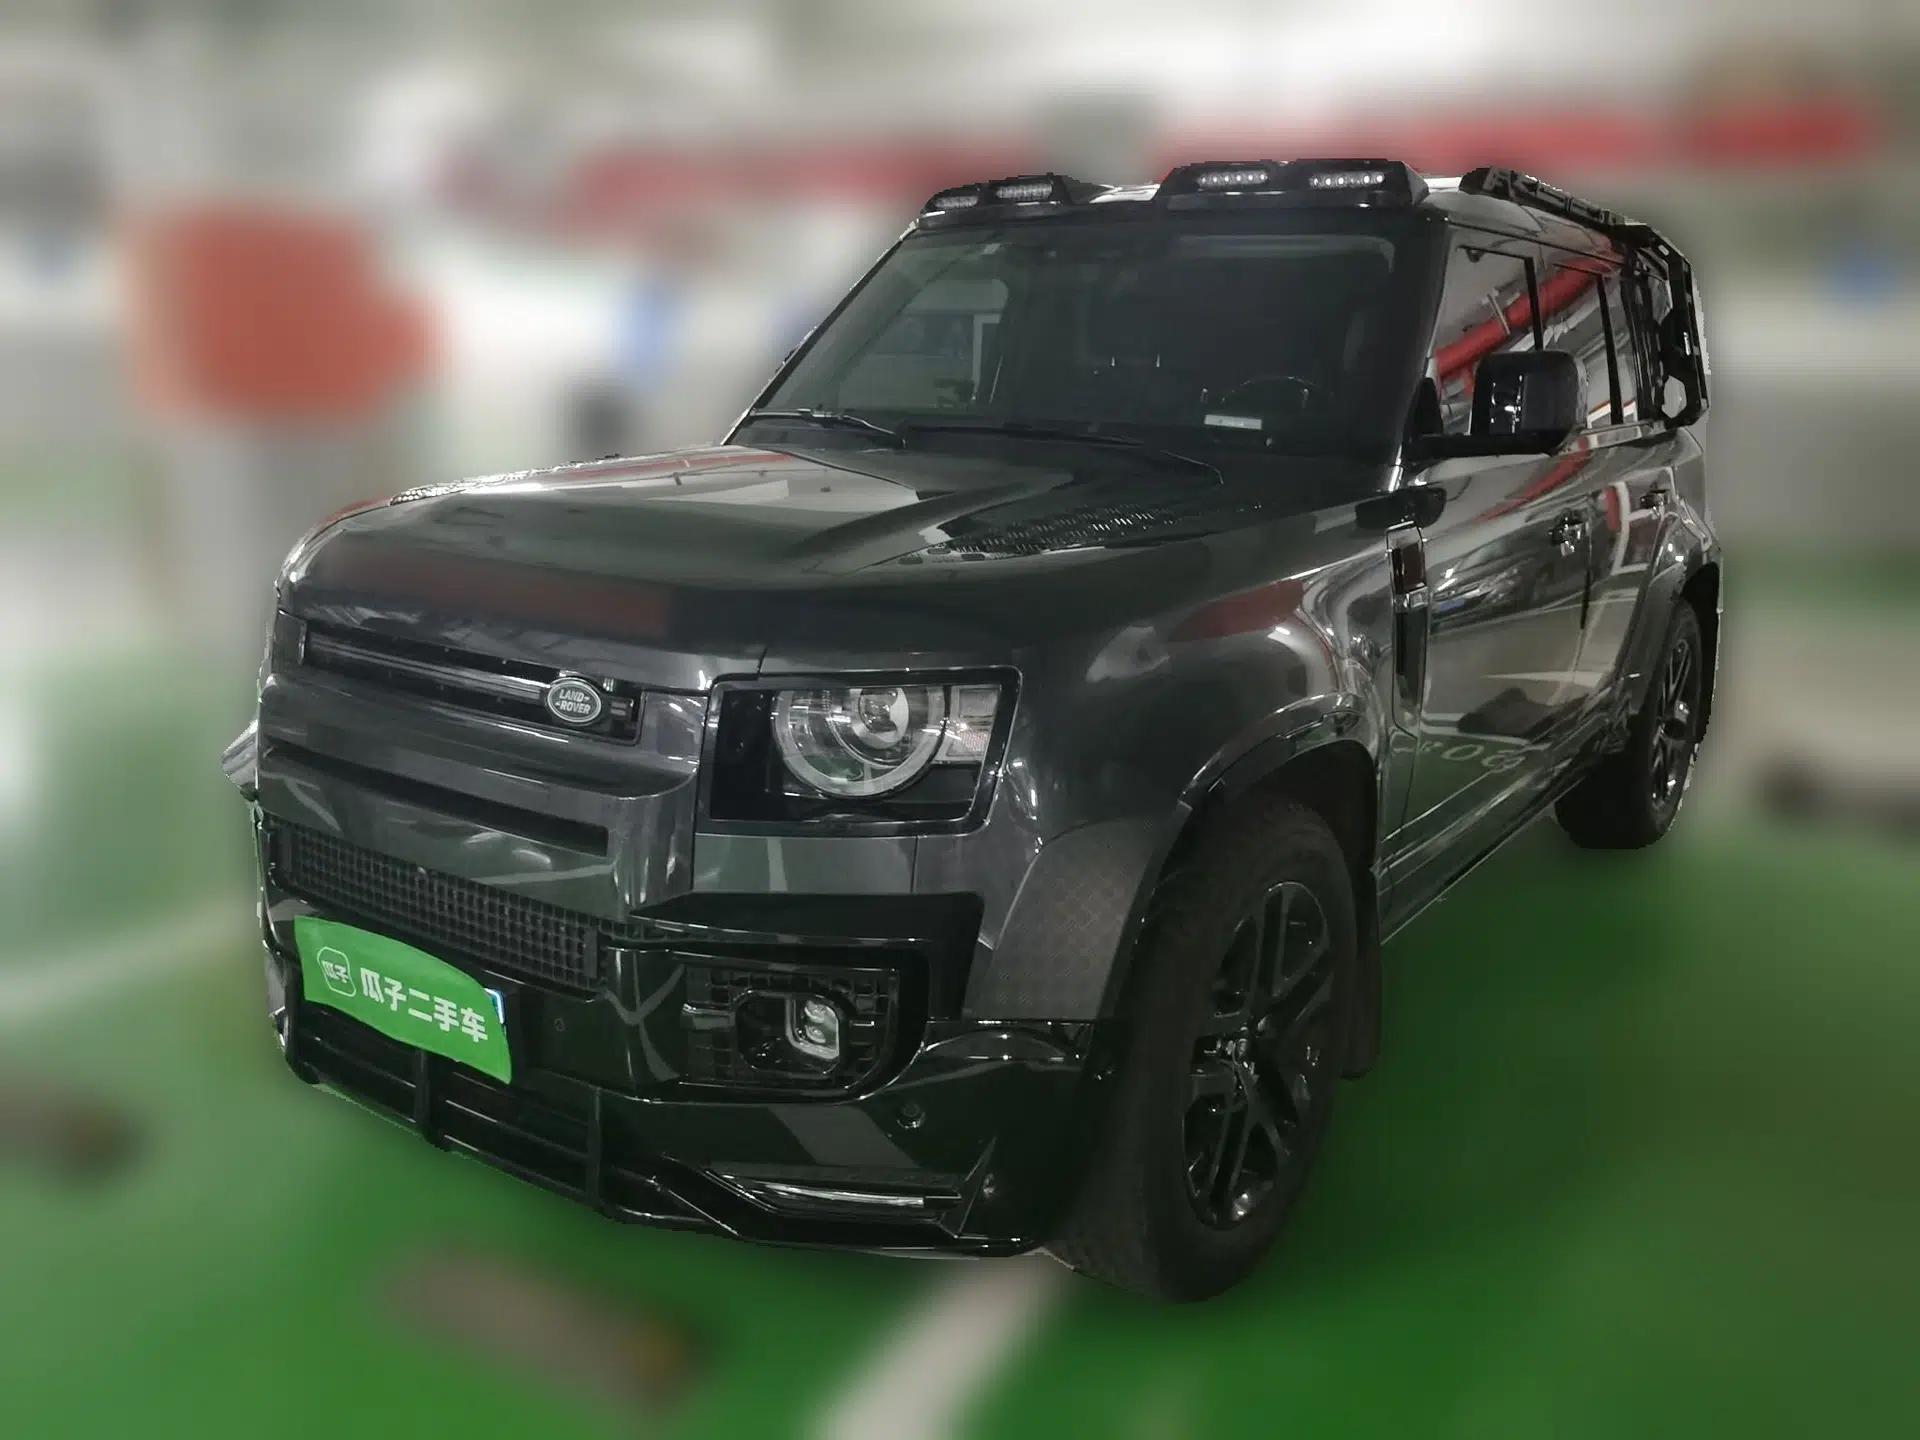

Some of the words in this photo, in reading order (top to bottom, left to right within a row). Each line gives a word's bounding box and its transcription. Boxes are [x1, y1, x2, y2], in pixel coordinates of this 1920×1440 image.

[321, 960, 349, 984] 瓜子
[360, 967, 489, 1043] 瓜子二手车
